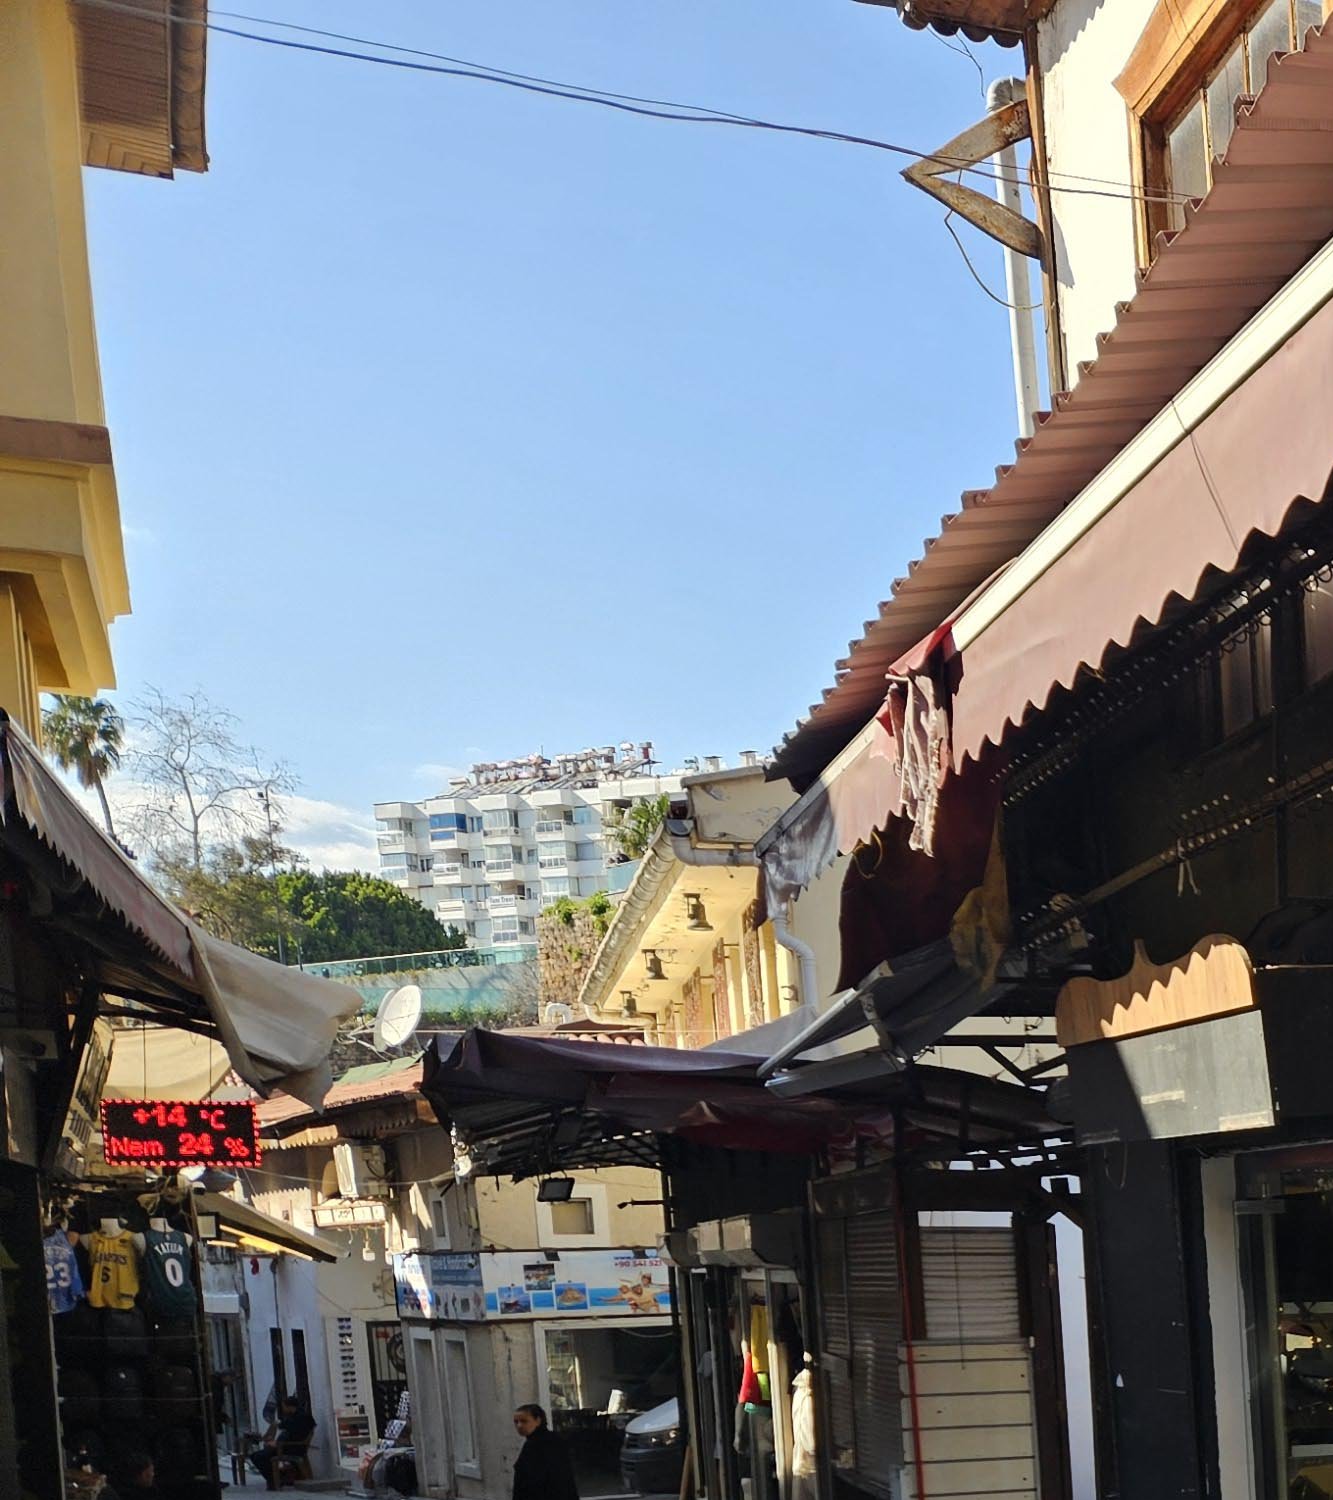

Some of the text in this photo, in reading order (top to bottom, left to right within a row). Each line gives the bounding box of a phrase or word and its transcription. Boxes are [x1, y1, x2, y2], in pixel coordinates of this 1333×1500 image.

[110, 1137, 164, 1156] Nem
[178, 1132, 214, 1156] 24
[154, 1242, 184, 1256] TATUM
[45, 1262, 71, 1288] 23
[164, 1257, 184, 1288] 0
